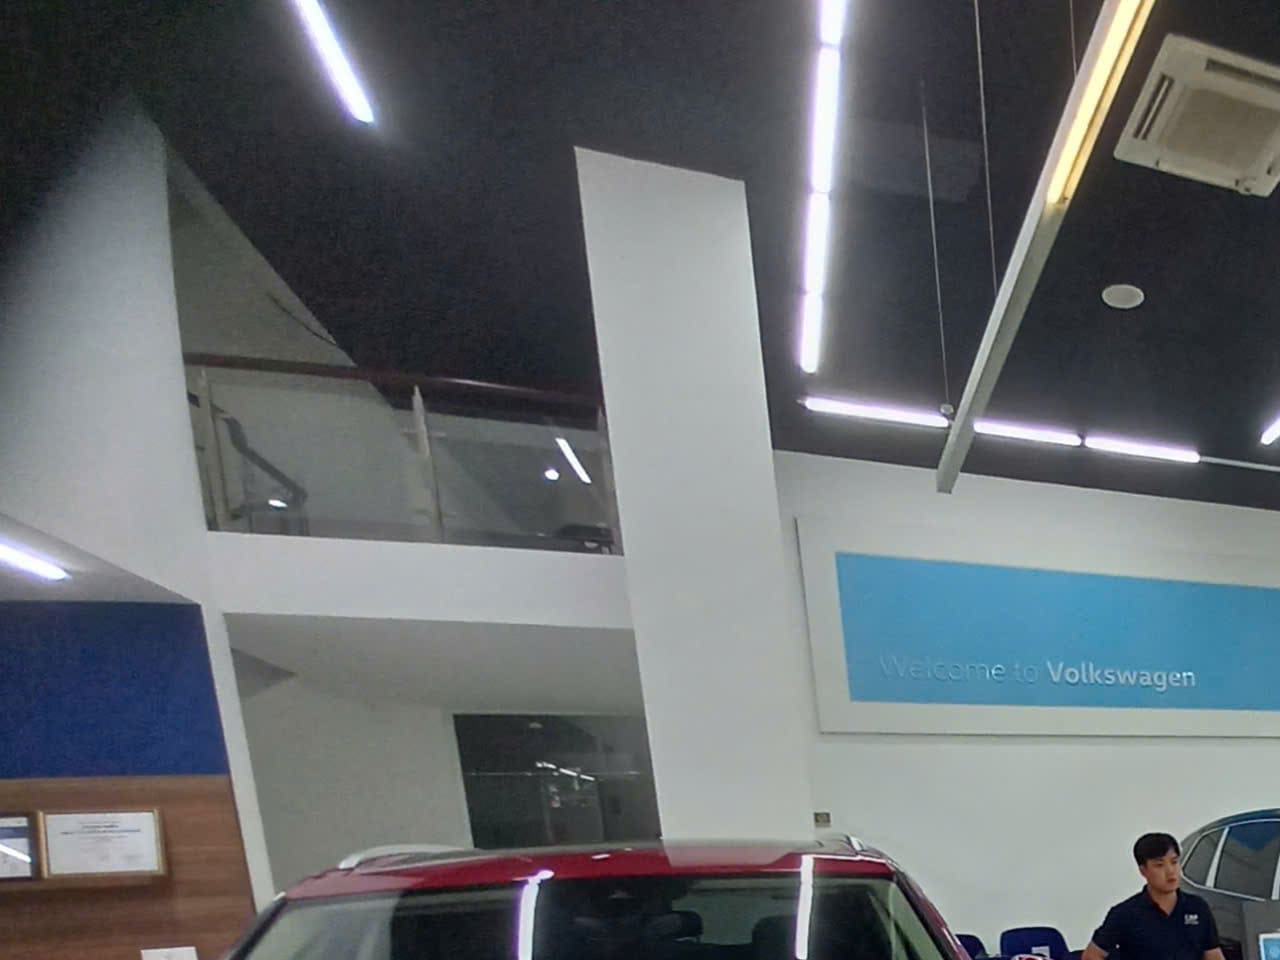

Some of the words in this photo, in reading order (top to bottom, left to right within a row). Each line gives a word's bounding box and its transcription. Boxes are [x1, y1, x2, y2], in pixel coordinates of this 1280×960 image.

[878, 654, 1006, 684] Welcome
[1014, 664, 1040, 685] to
[1046, 660, 1197, 692] Volkswagen
